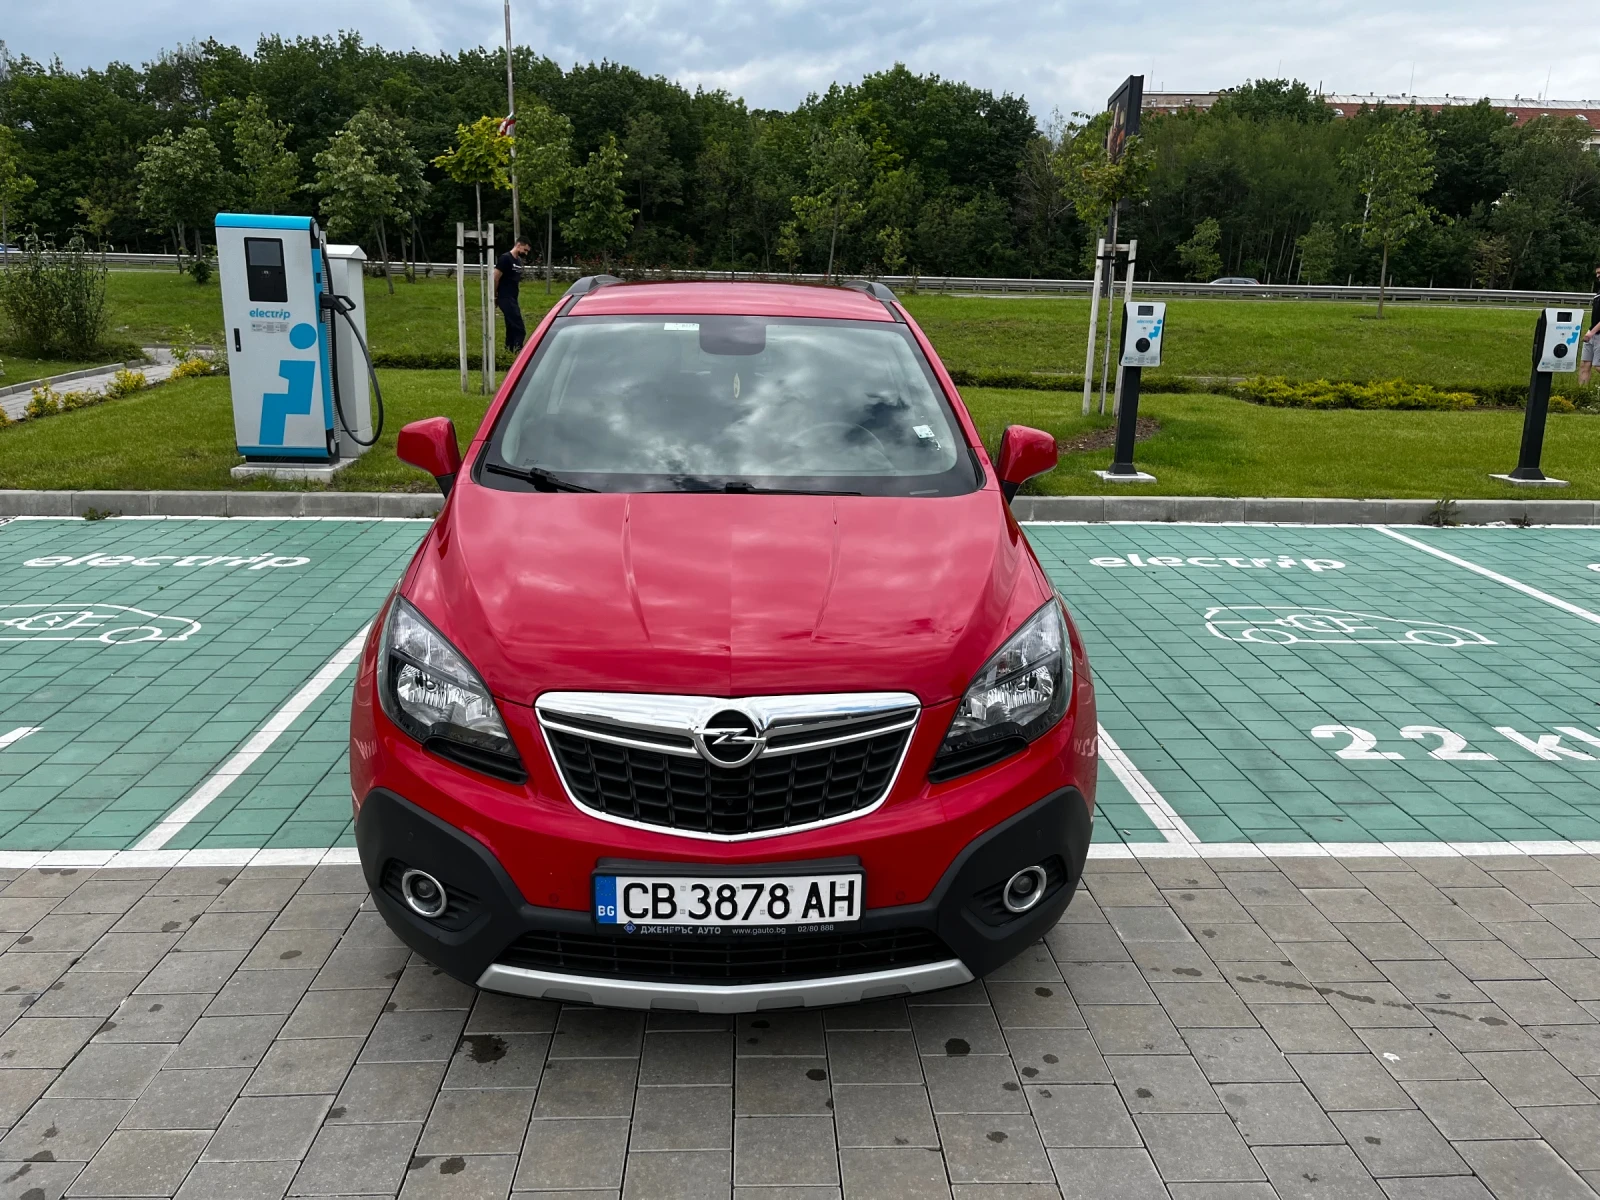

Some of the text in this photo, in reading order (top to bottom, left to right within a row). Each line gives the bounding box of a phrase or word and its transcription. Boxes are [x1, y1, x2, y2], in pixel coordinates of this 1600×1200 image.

[249, 308, 291, 320] electrip
[23, 552, 311, 570] electrip
[1089, 553, 1346, 572] electrip
[1311, 725, 1499, 760] 22
[623, 880, 855, 921] CB 3878 AH
[597, 905, 615, 917] BG
[732, 926, 786, 935] www.gauto.bg
